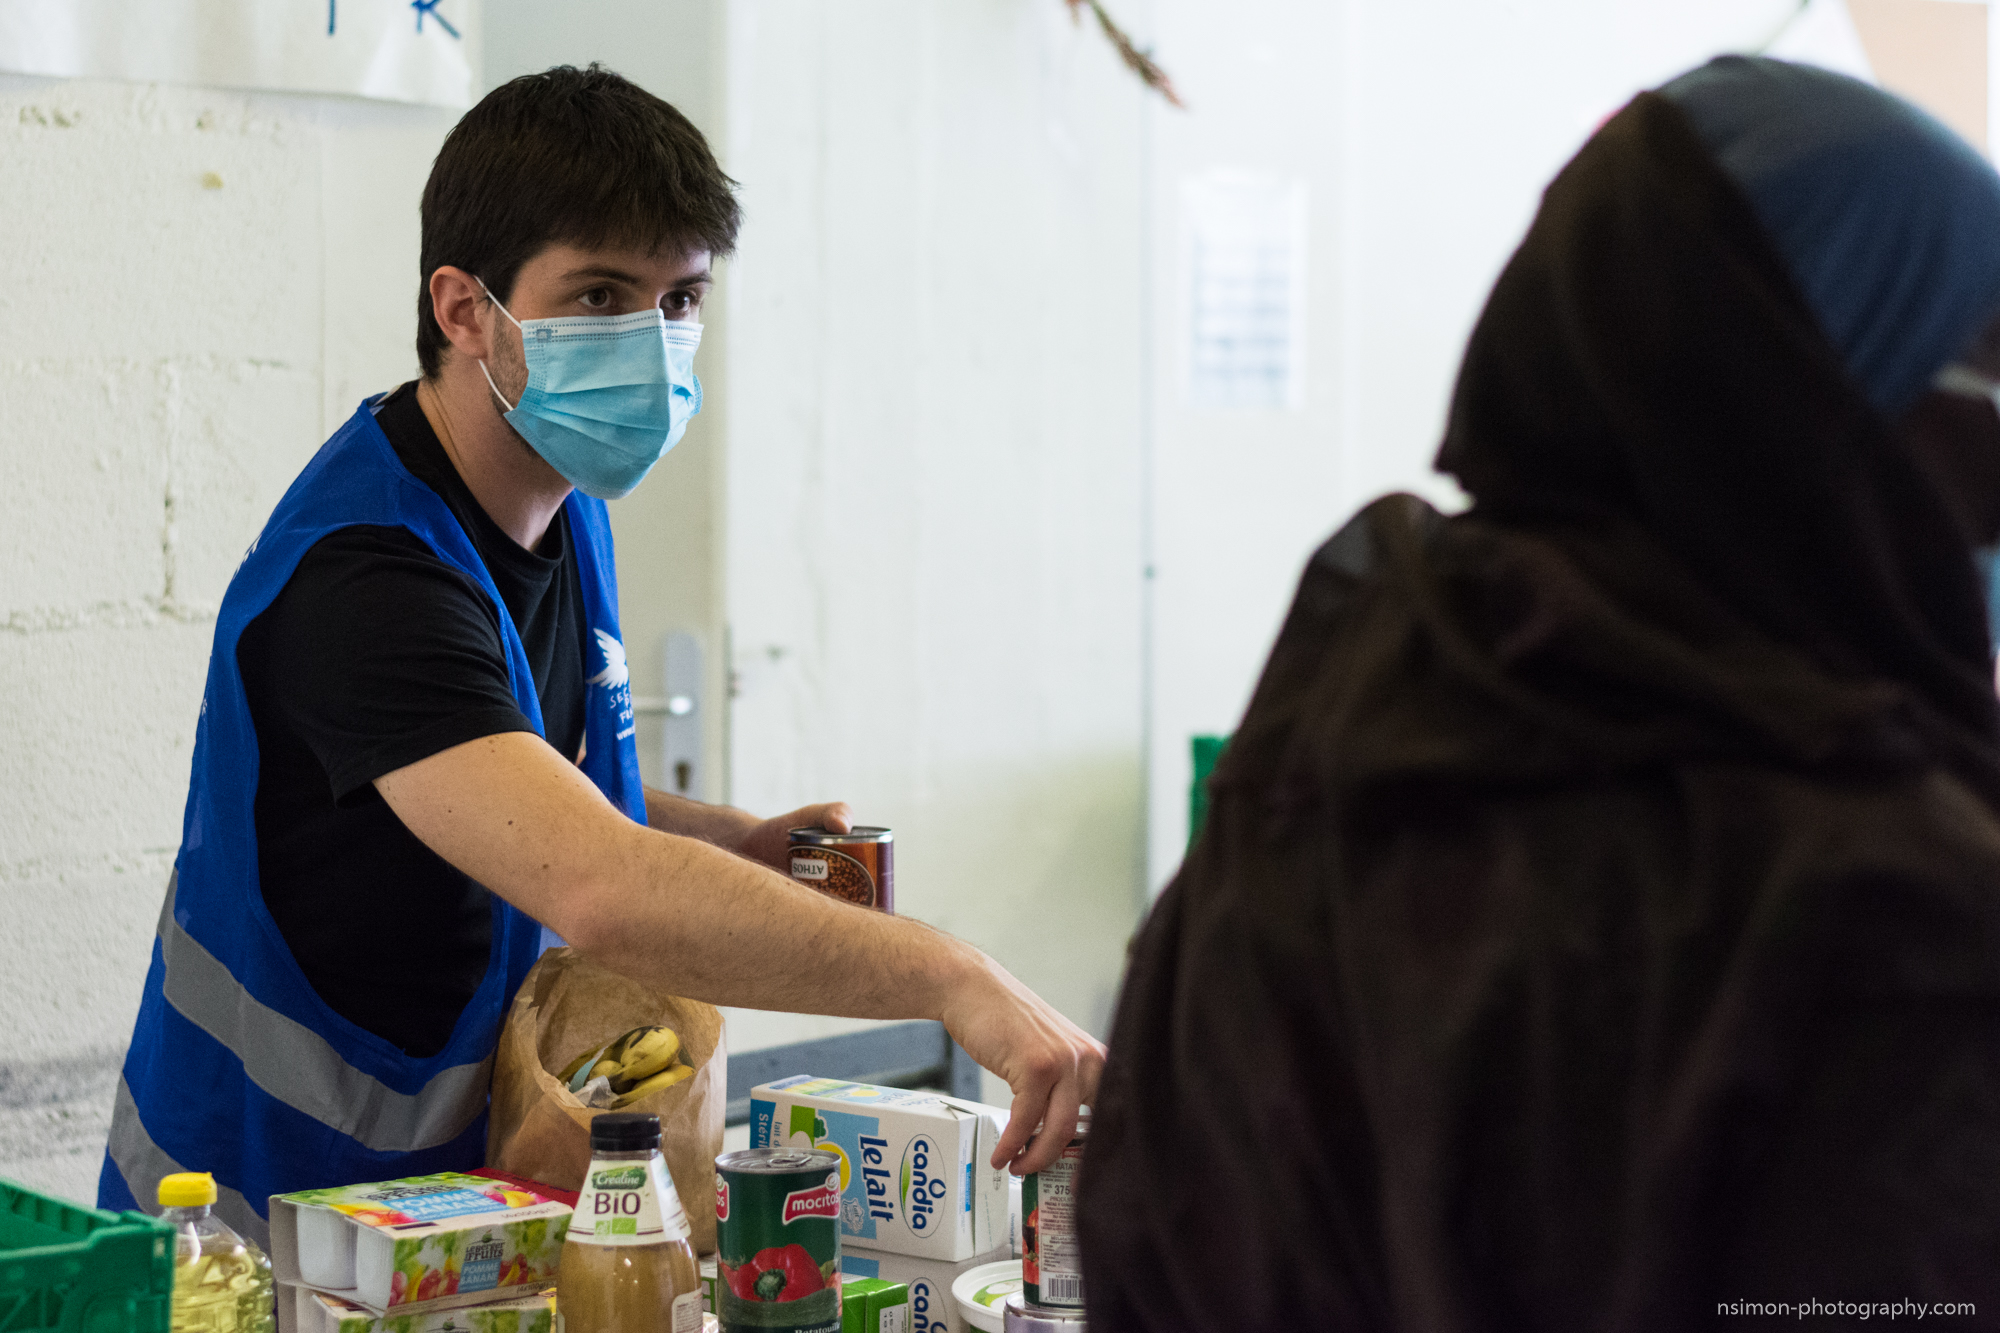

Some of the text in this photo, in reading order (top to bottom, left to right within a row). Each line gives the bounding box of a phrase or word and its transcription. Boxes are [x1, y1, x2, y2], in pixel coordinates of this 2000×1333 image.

[793, 862, 824, 875] ATHOS
[757, 1113, 769, 1149] Stéril
[912, 1139, 934, 1230] candia
[1054, 1184, 1071, 1195] 375
[389, 1190, 480, 1210] POMME
[401, 1197, 499, 1217] BANANE
[594, 1191, 641, 1215] BiO
[791, 1192, 840, 1212] mocitos
[463, 1262, 499, 1274] POMME
[459, 1272, 498, 1285] BANANE
[914, 1283, 930, 1333] can
